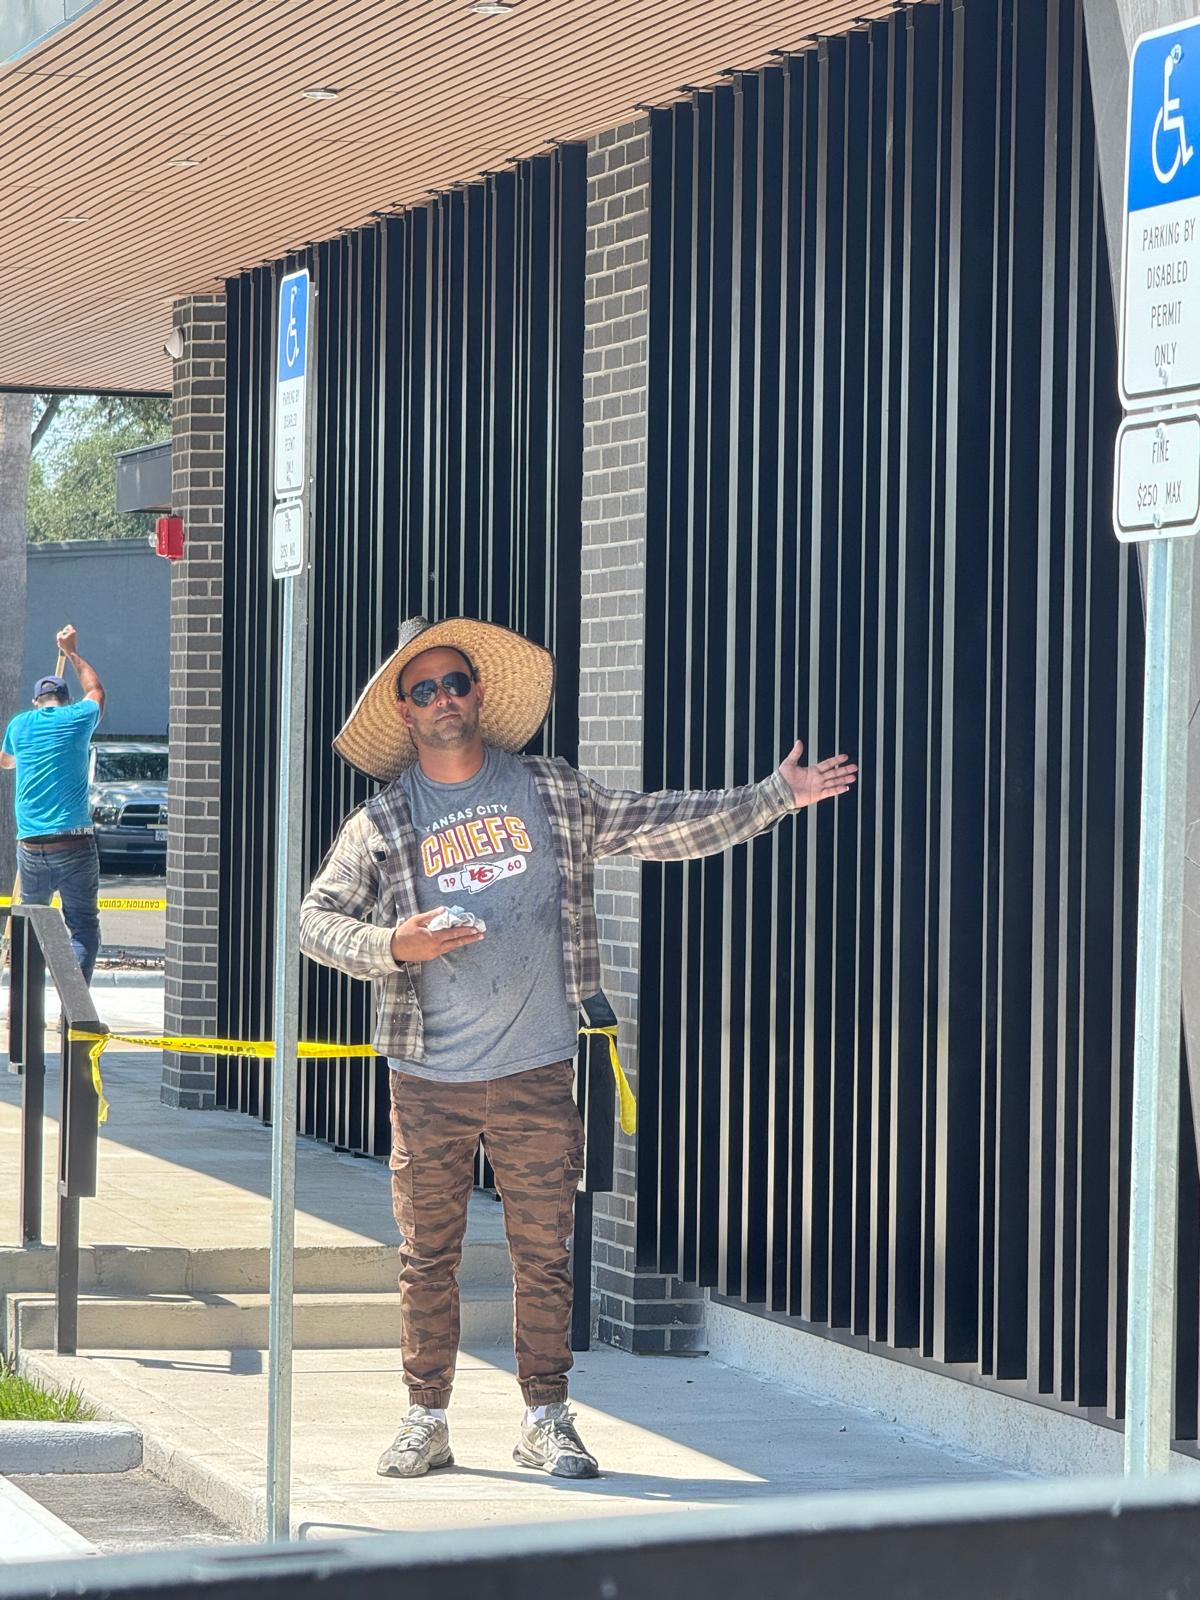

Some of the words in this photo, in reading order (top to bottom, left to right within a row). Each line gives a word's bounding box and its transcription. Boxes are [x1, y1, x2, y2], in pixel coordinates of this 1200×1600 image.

[1142, 222, 1180, 251] PARKING
[1184, 217, 1196, 242] BY
[1146, 260, 1188, 289] DISABLED
[1150, 301, 1182, 328] PERMIT
[1154, 342, 1177, 367] ONLY
[1152, 439, 1170, 464] FINE
[1136, 482, 1158, 511] $250
[1165, 480, 1182, 505] MAX
[476, 804, 508, 816] CITY
[420, 815, 533, 878] CHIEFS
[443, 877, 456, 888] 19
[507, 860, 522, 872] 60
